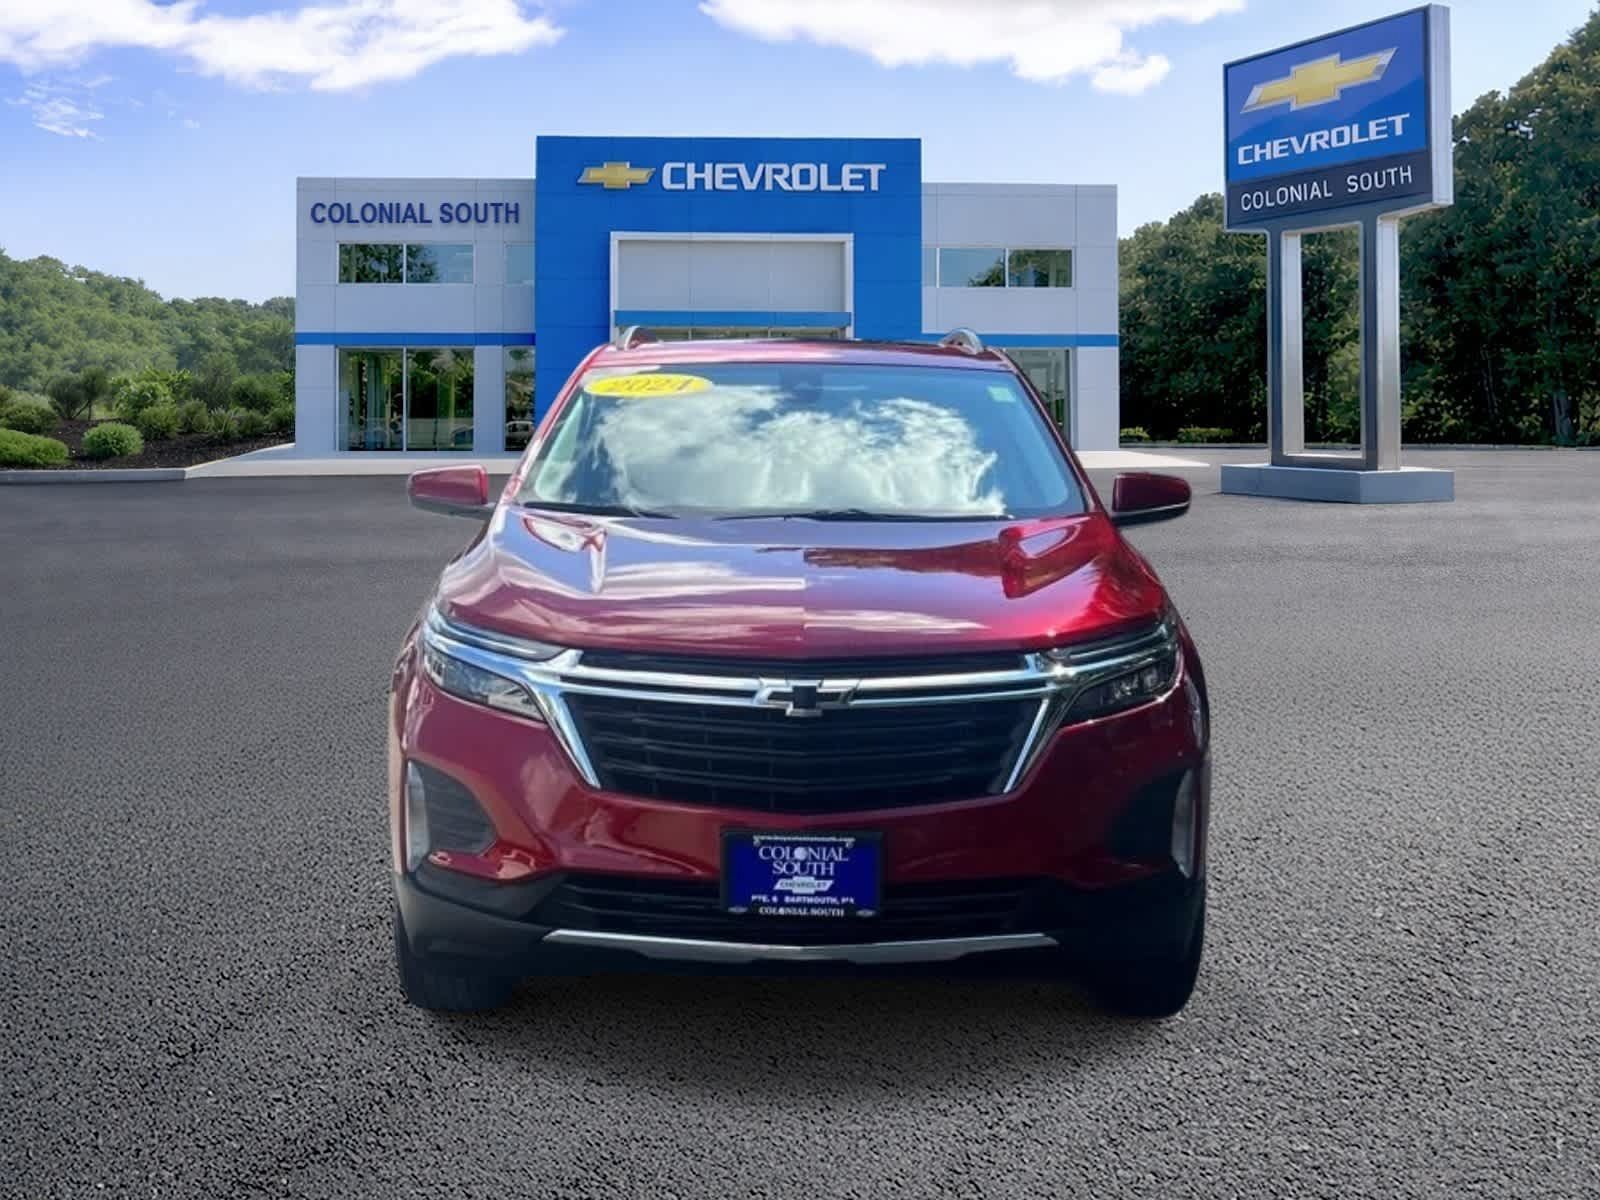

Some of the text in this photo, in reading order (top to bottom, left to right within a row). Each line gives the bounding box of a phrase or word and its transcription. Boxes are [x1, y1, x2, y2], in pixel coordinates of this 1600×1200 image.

[1238, 113, 1410, 165] CHEVROLET
[662, 162, 887, 192] CHEVROLET
[1240, 165, 1413, 211] COLONIAL SOUTH
[310, 202, 520, 225] COLONIAL SOUTH
[758, 845, 849, 861] COLONIAL
[772, 861, 835, 875] SOUTH
[759, 907, 845, 917] COLONIAL SOUTH
